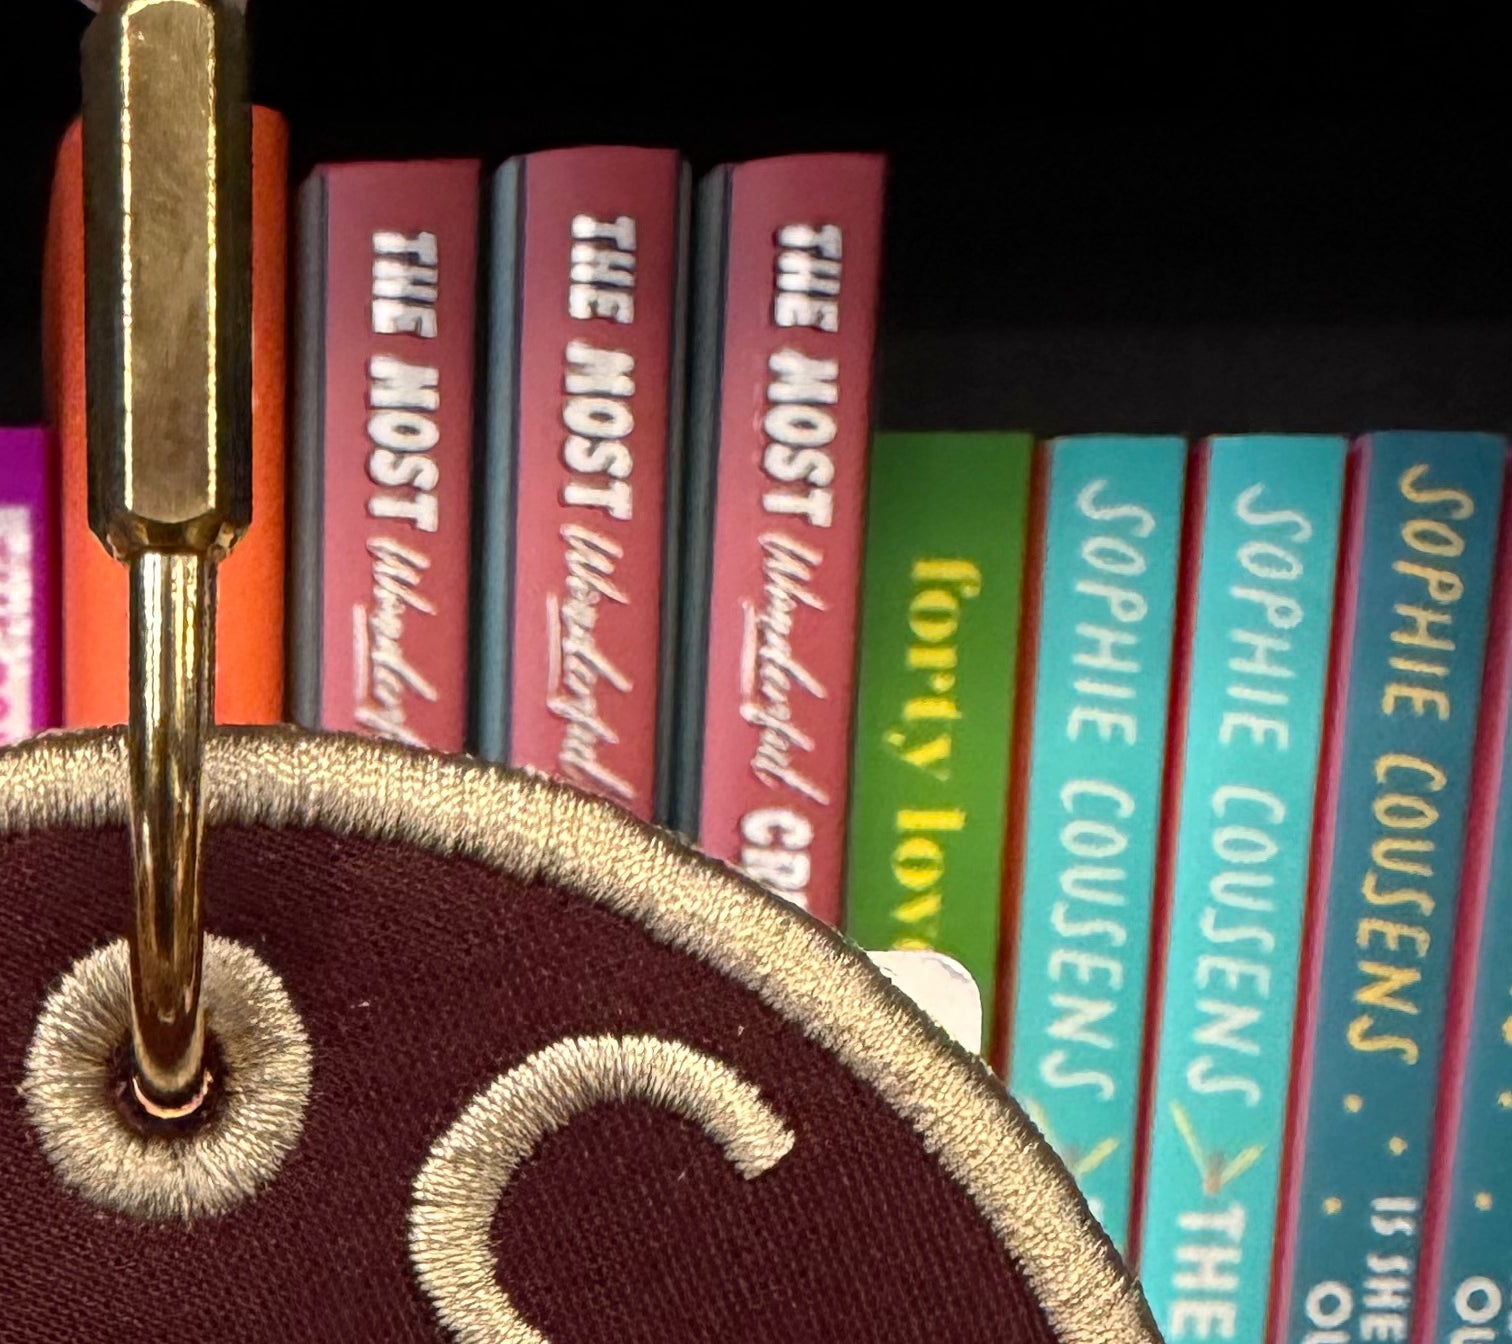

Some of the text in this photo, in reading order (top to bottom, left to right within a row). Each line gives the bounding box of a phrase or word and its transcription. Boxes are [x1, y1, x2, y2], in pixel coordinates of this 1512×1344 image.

[371, 230, 439, 339] THE
[774, 224, 842, 332] THE
[367, 355, 440, 531] MOST
[547, 215, 636, 799] THE MOST Wonderful
[762, 350, 840, 529] MOST
[740, 532, 829, 805] Wonderful
[884, 557, 981, 781] forty
[1039, 479, 1156, 1100] SOPHIE COUSENS
[1187, 482, 1311, 1106] SOPHIE COUSENS
[1346, 463, 1475, 1065] SOPHIE COUSENS
[1170, 1202, 1246, 1340] THE
[1361, 1249, 1411, 1340] SHE
[1372, 1196, 1417, 1236] IS
